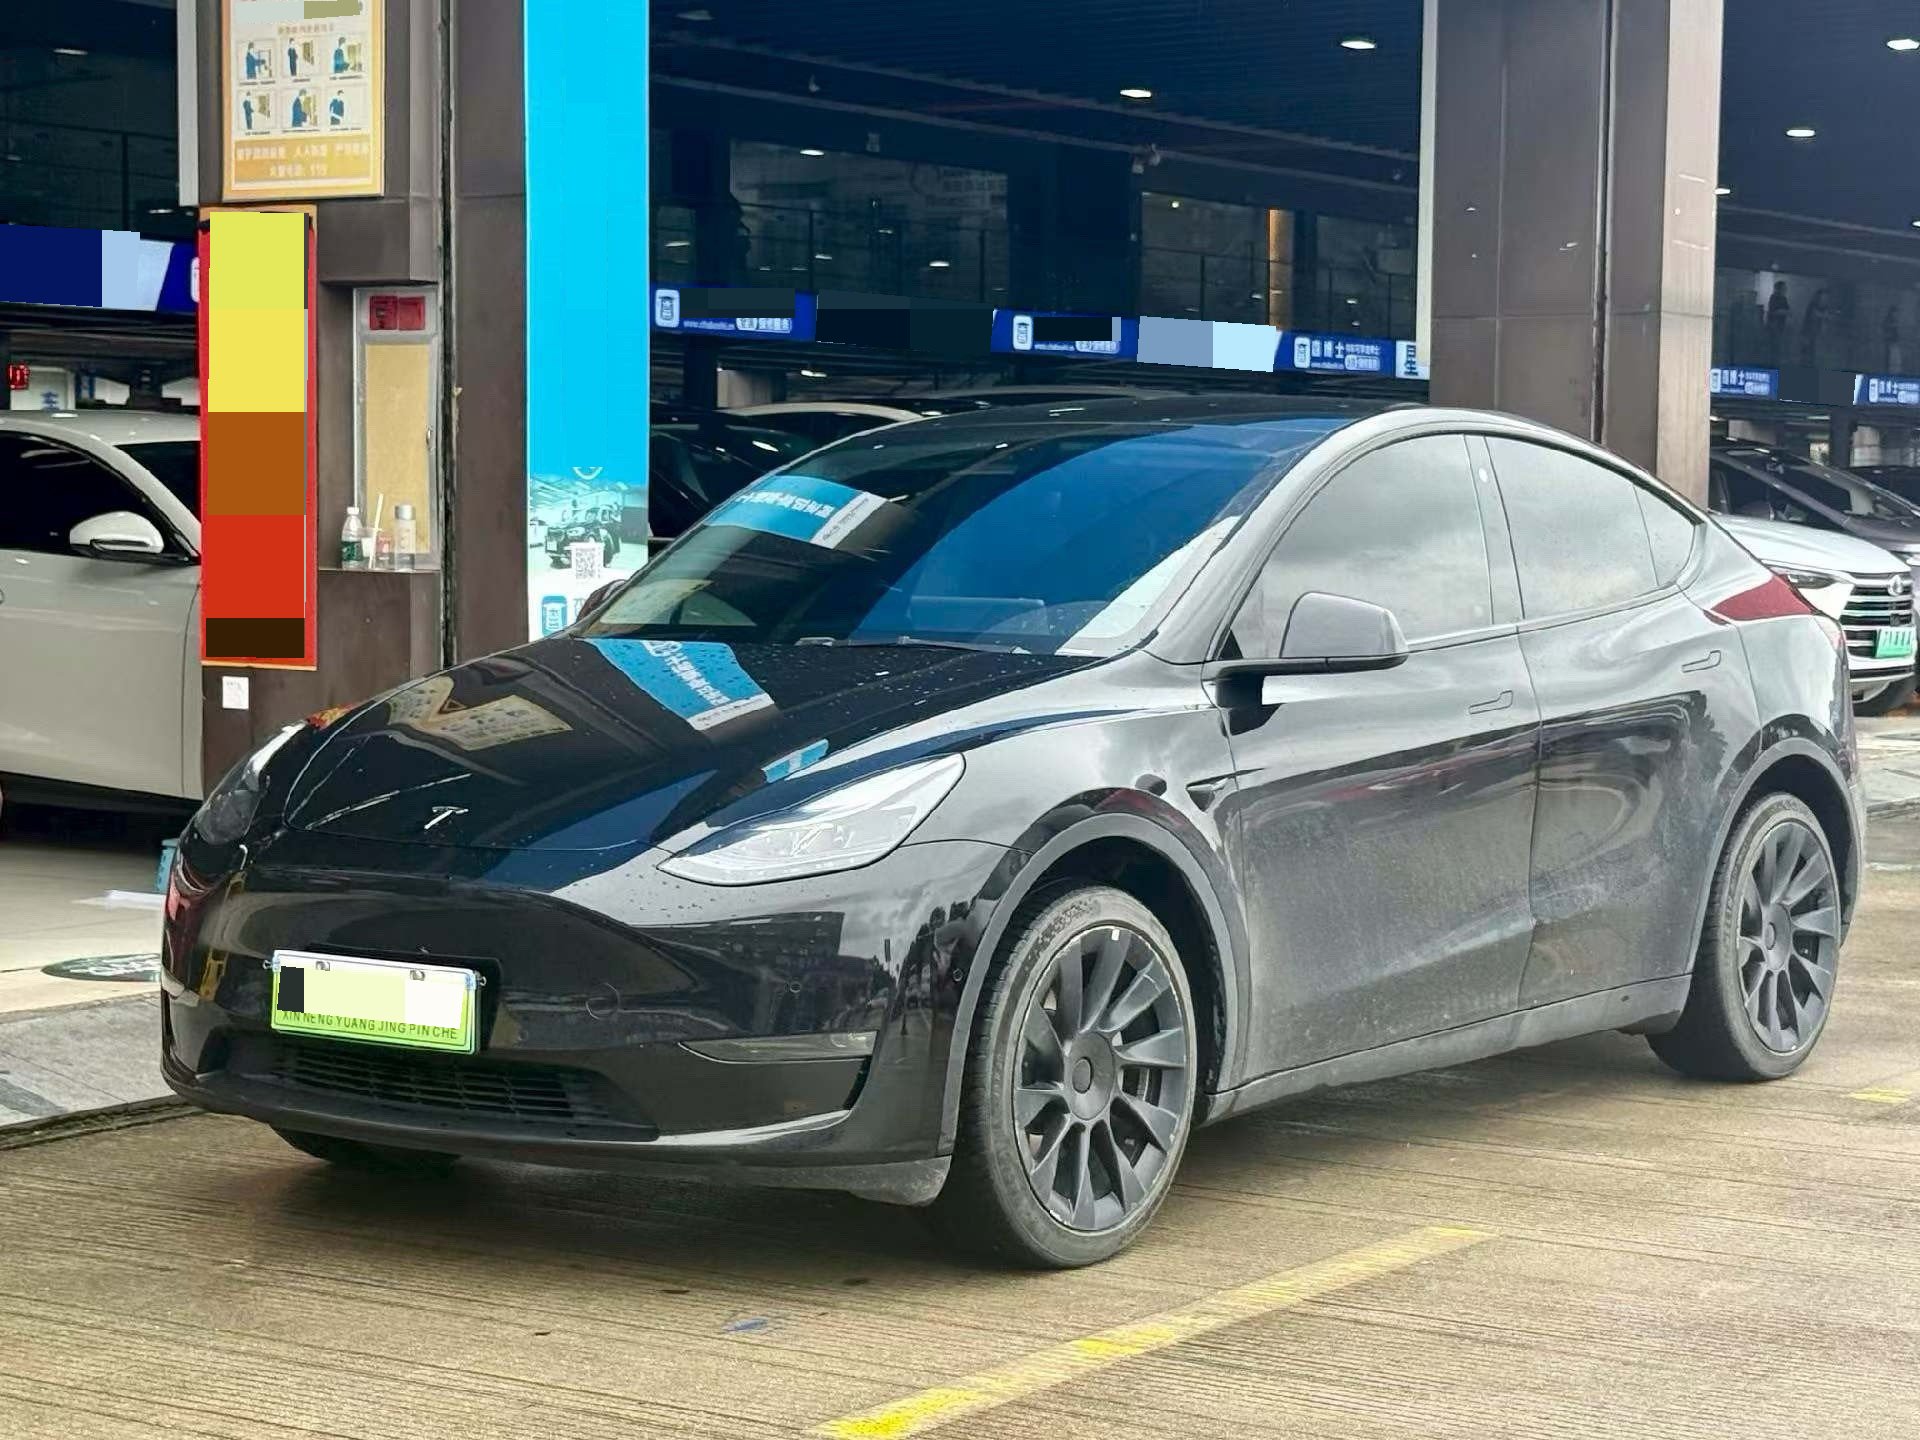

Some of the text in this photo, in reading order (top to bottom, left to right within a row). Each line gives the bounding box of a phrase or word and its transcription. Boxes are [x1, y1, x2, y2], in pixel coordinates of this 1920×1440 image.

[282, 1010, 458, 1040] XIN NENG YUANG JING PIN CHE
